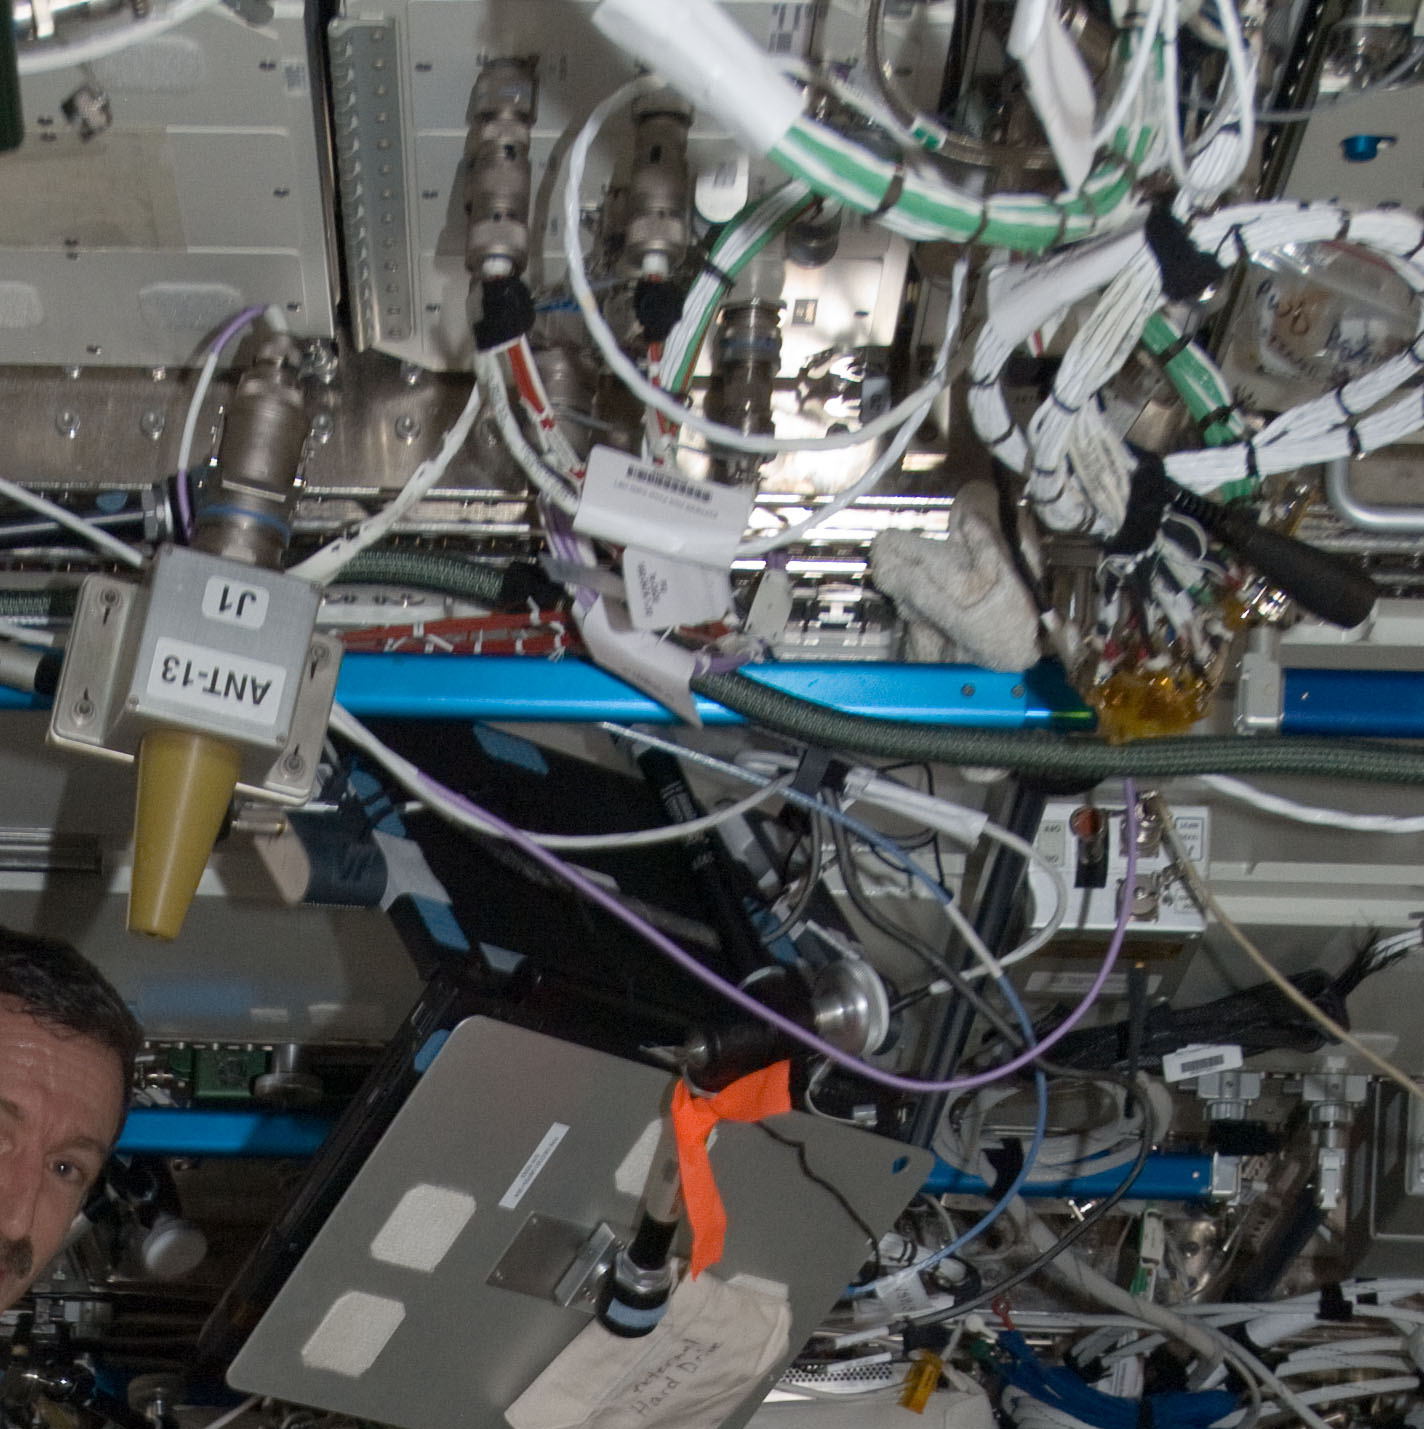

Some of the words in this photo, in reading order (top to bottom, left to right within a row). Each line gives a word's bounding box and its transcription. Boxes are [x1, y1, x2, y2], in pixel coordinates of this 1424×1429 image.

[217, 586, 257, 617] J1
[161, 656, 271, 704] ANT-13
[631, 1377, 681, 1417] Hard
